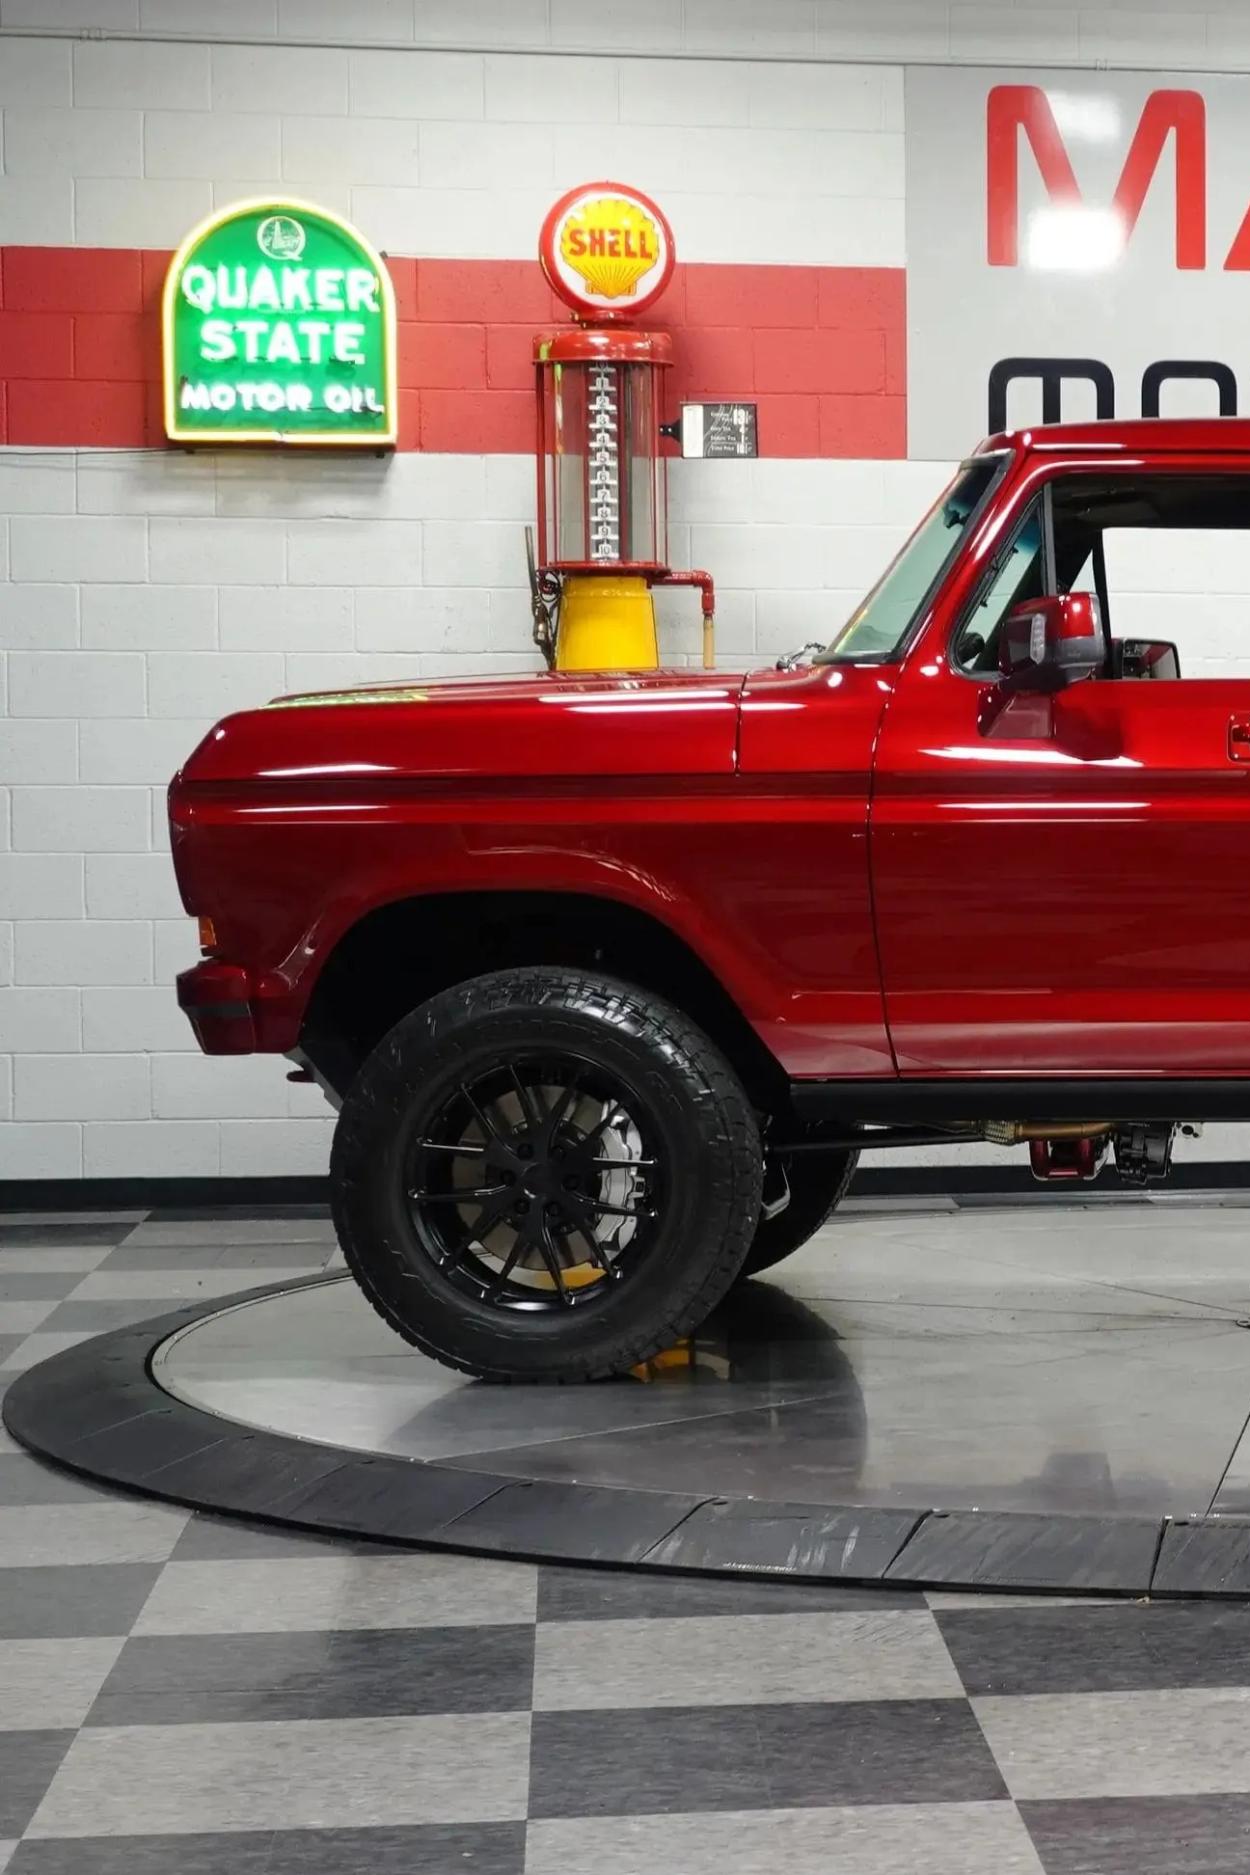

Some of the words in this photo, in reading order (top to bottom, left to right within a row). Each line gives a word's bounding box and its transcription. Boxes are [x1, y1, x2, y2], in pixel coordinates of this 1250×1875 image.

[568, 228, 653, 260] SHELL
[181, 264, 380, 314] QUAKER
[200, 319, 366, 365] STATE
[181, 380, 313, 412] MOTOR
[323, 383, 384, 413] OIL
